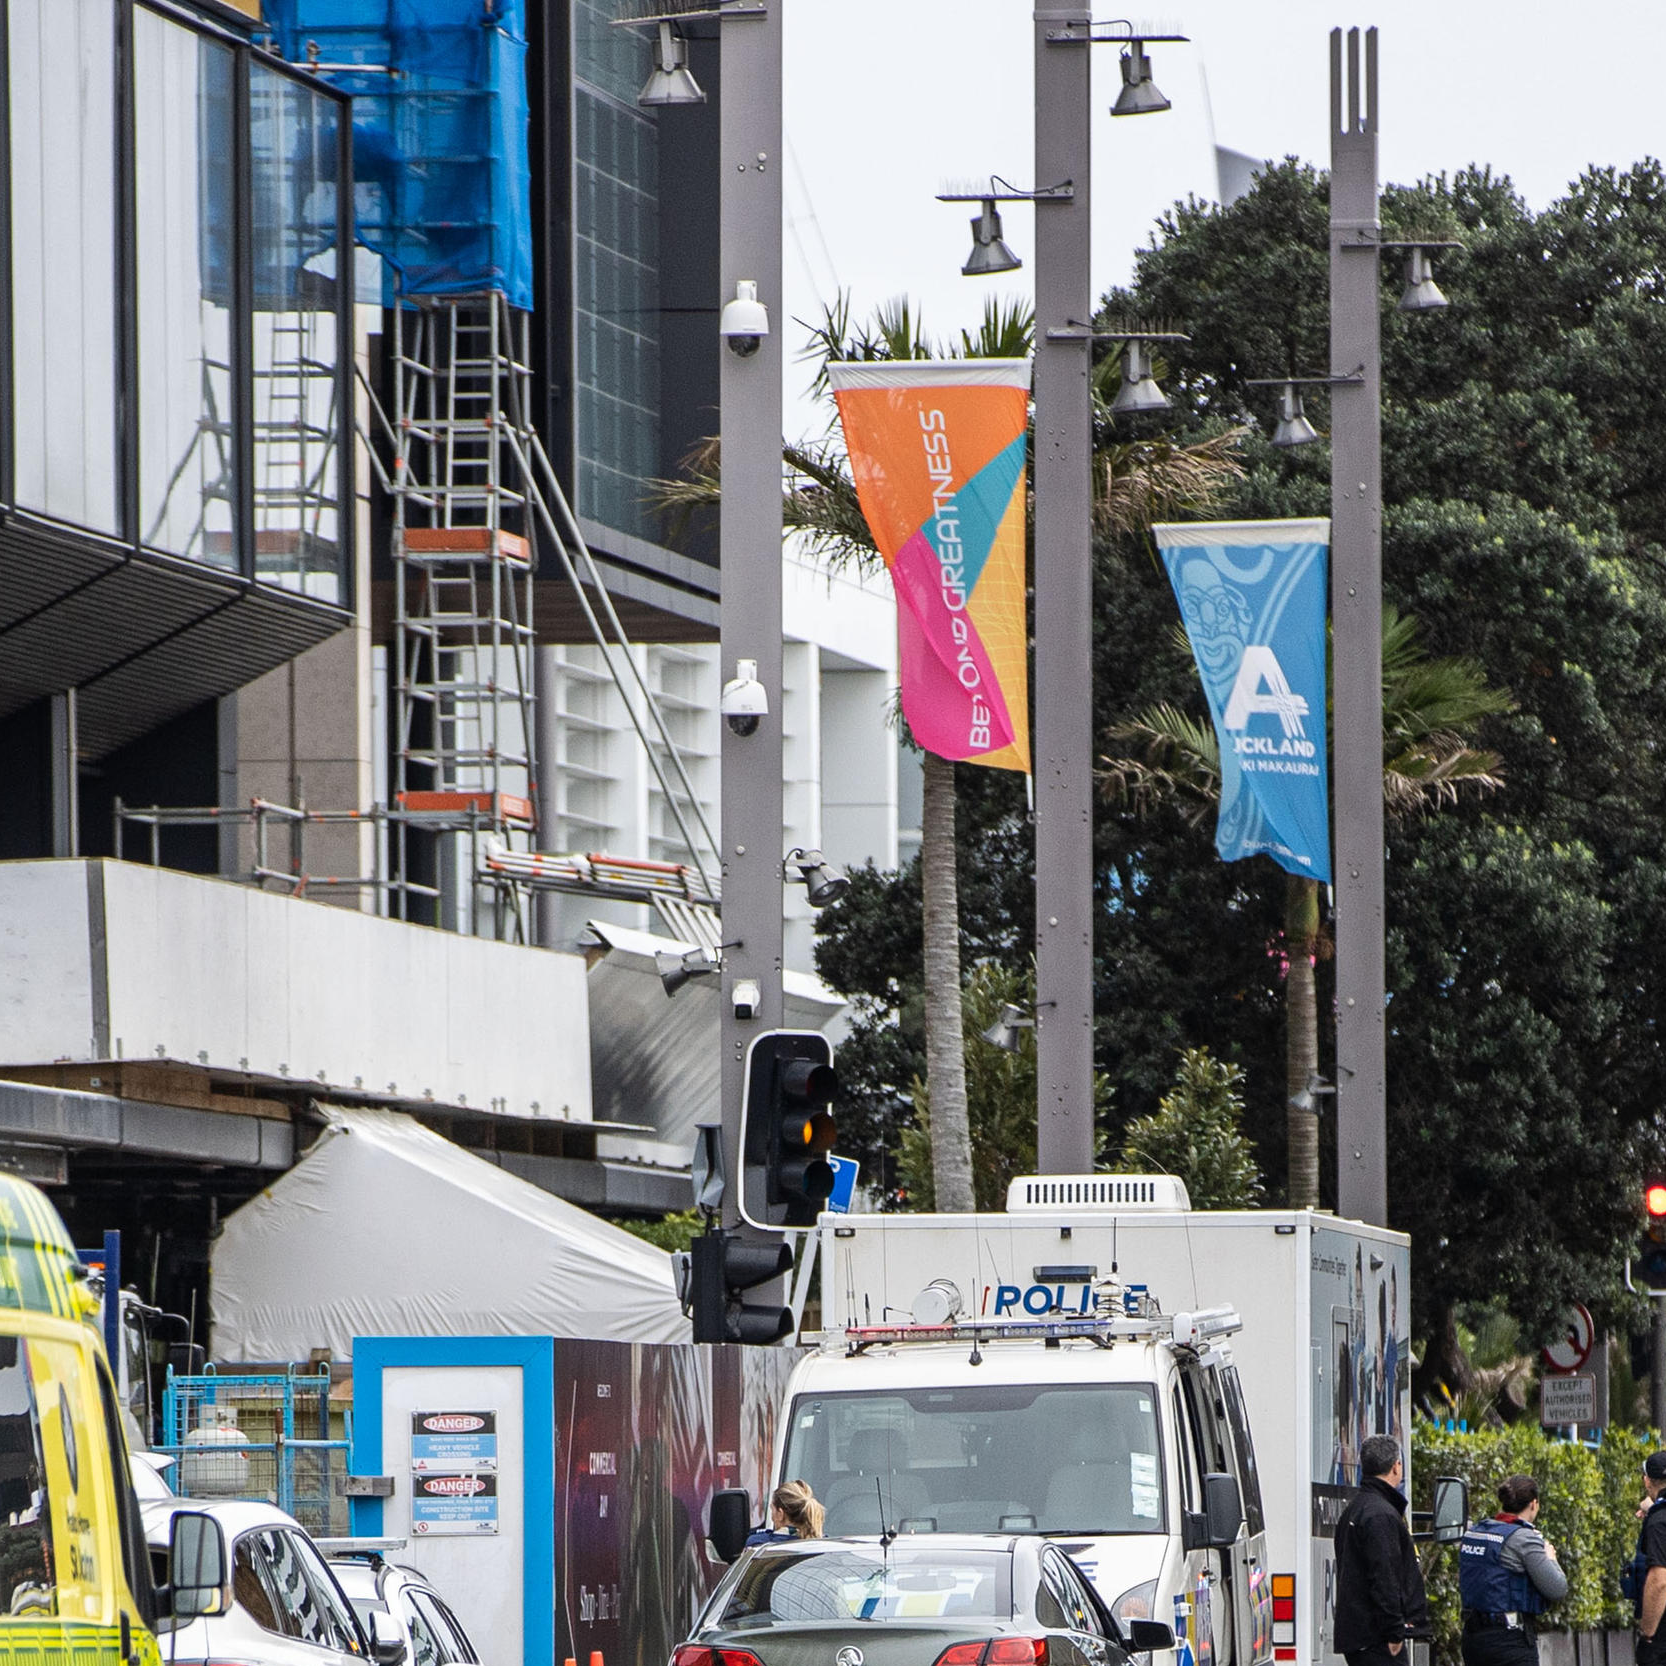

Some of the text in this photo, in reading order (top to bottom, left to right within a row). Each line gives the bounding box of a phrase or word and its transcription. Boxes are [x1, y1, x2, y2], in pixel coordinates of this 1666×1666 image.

[919, 408, 967, 613] GREATNESS
[1232, 737, 1316, 758] UCKLAND
[1552, 1380, 1583, 1391] EXCEPT
[1545, 1393, 1592, 1407] AUTHORISED
[1549, 1409, 1589, 1420] VEHICLES
[429, 1419, 478, 1429] DANGER
[430, 1481, 480, 1491] DANGER
[1461, 1543, 1486, 1555] POLICE
